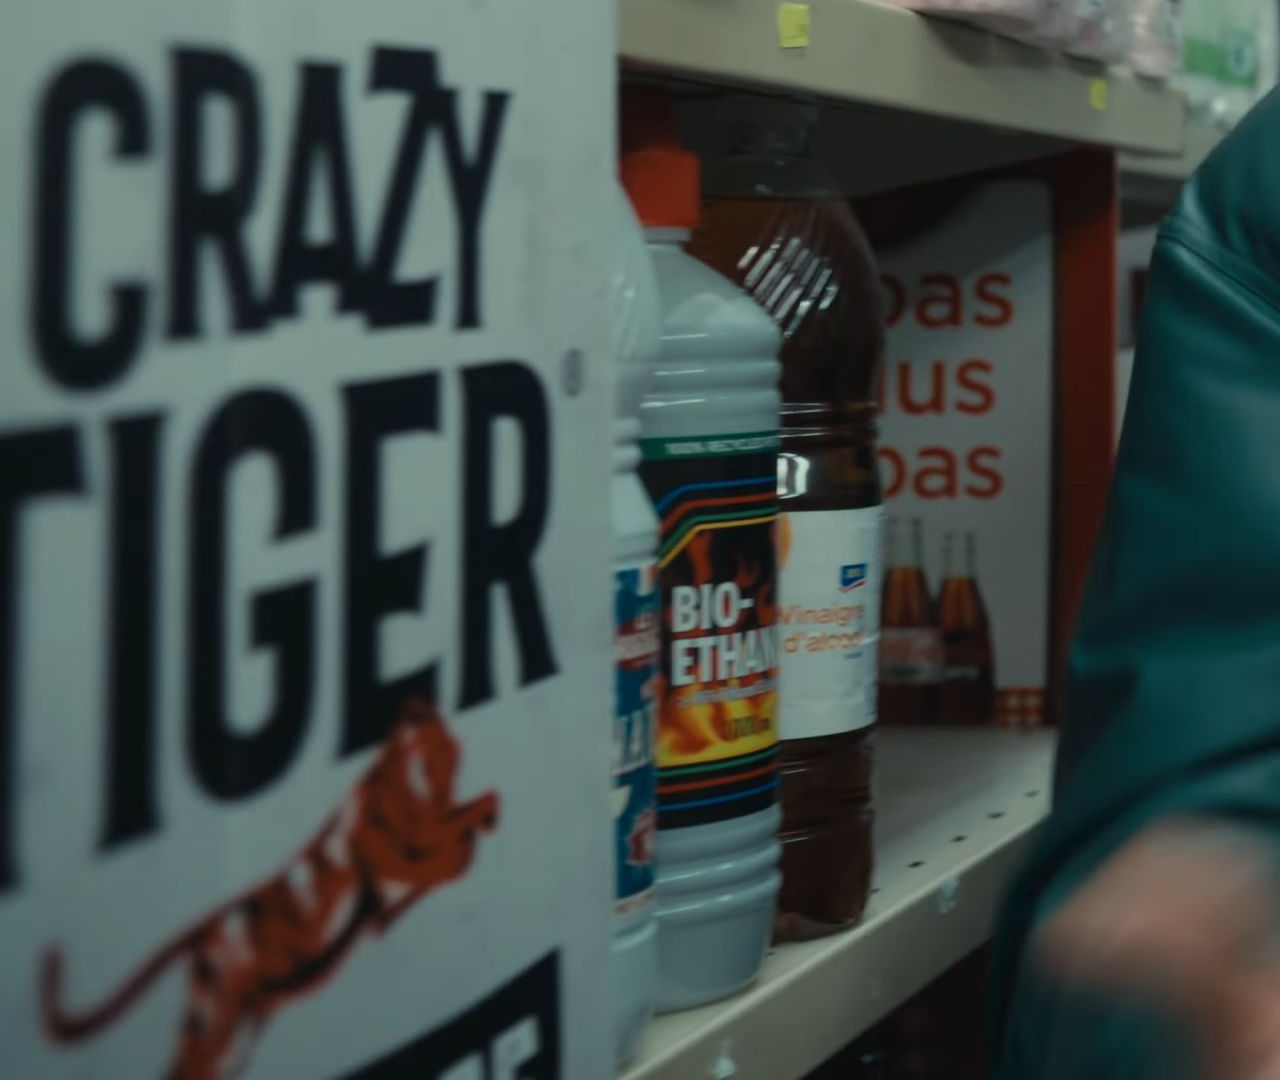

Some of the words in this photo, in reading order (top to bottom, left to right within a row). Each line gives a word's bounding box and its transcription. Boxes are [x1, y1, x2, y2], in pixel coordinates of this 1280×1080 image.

[28, 42, 512, 394] CRAZY
[0, 360, 561, 895] TIGER
[671, 581, 754, 632] BIO-
